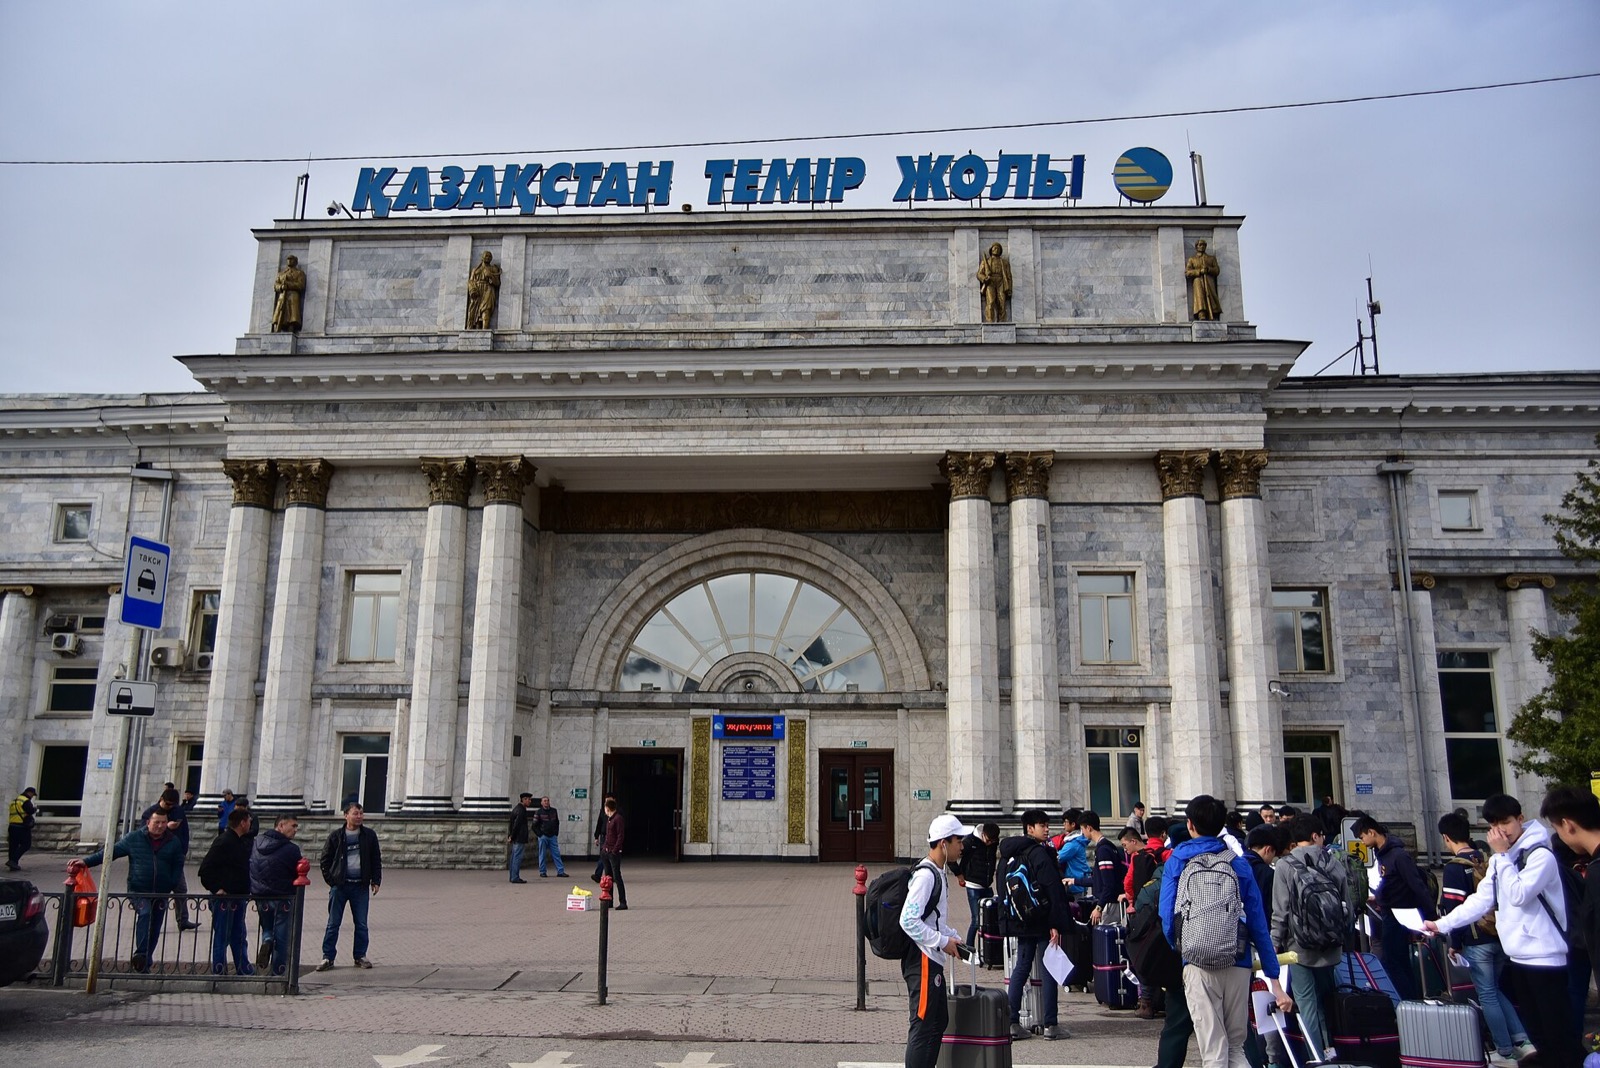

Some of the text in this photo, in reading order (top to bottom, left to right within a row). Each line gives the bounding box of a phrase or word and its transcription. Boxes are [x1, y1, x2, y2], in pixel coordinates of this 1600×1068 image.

[352, 153, 1086, 217] ҚАЗАҚСТАН ТЕМІР ЖОЛЫ
